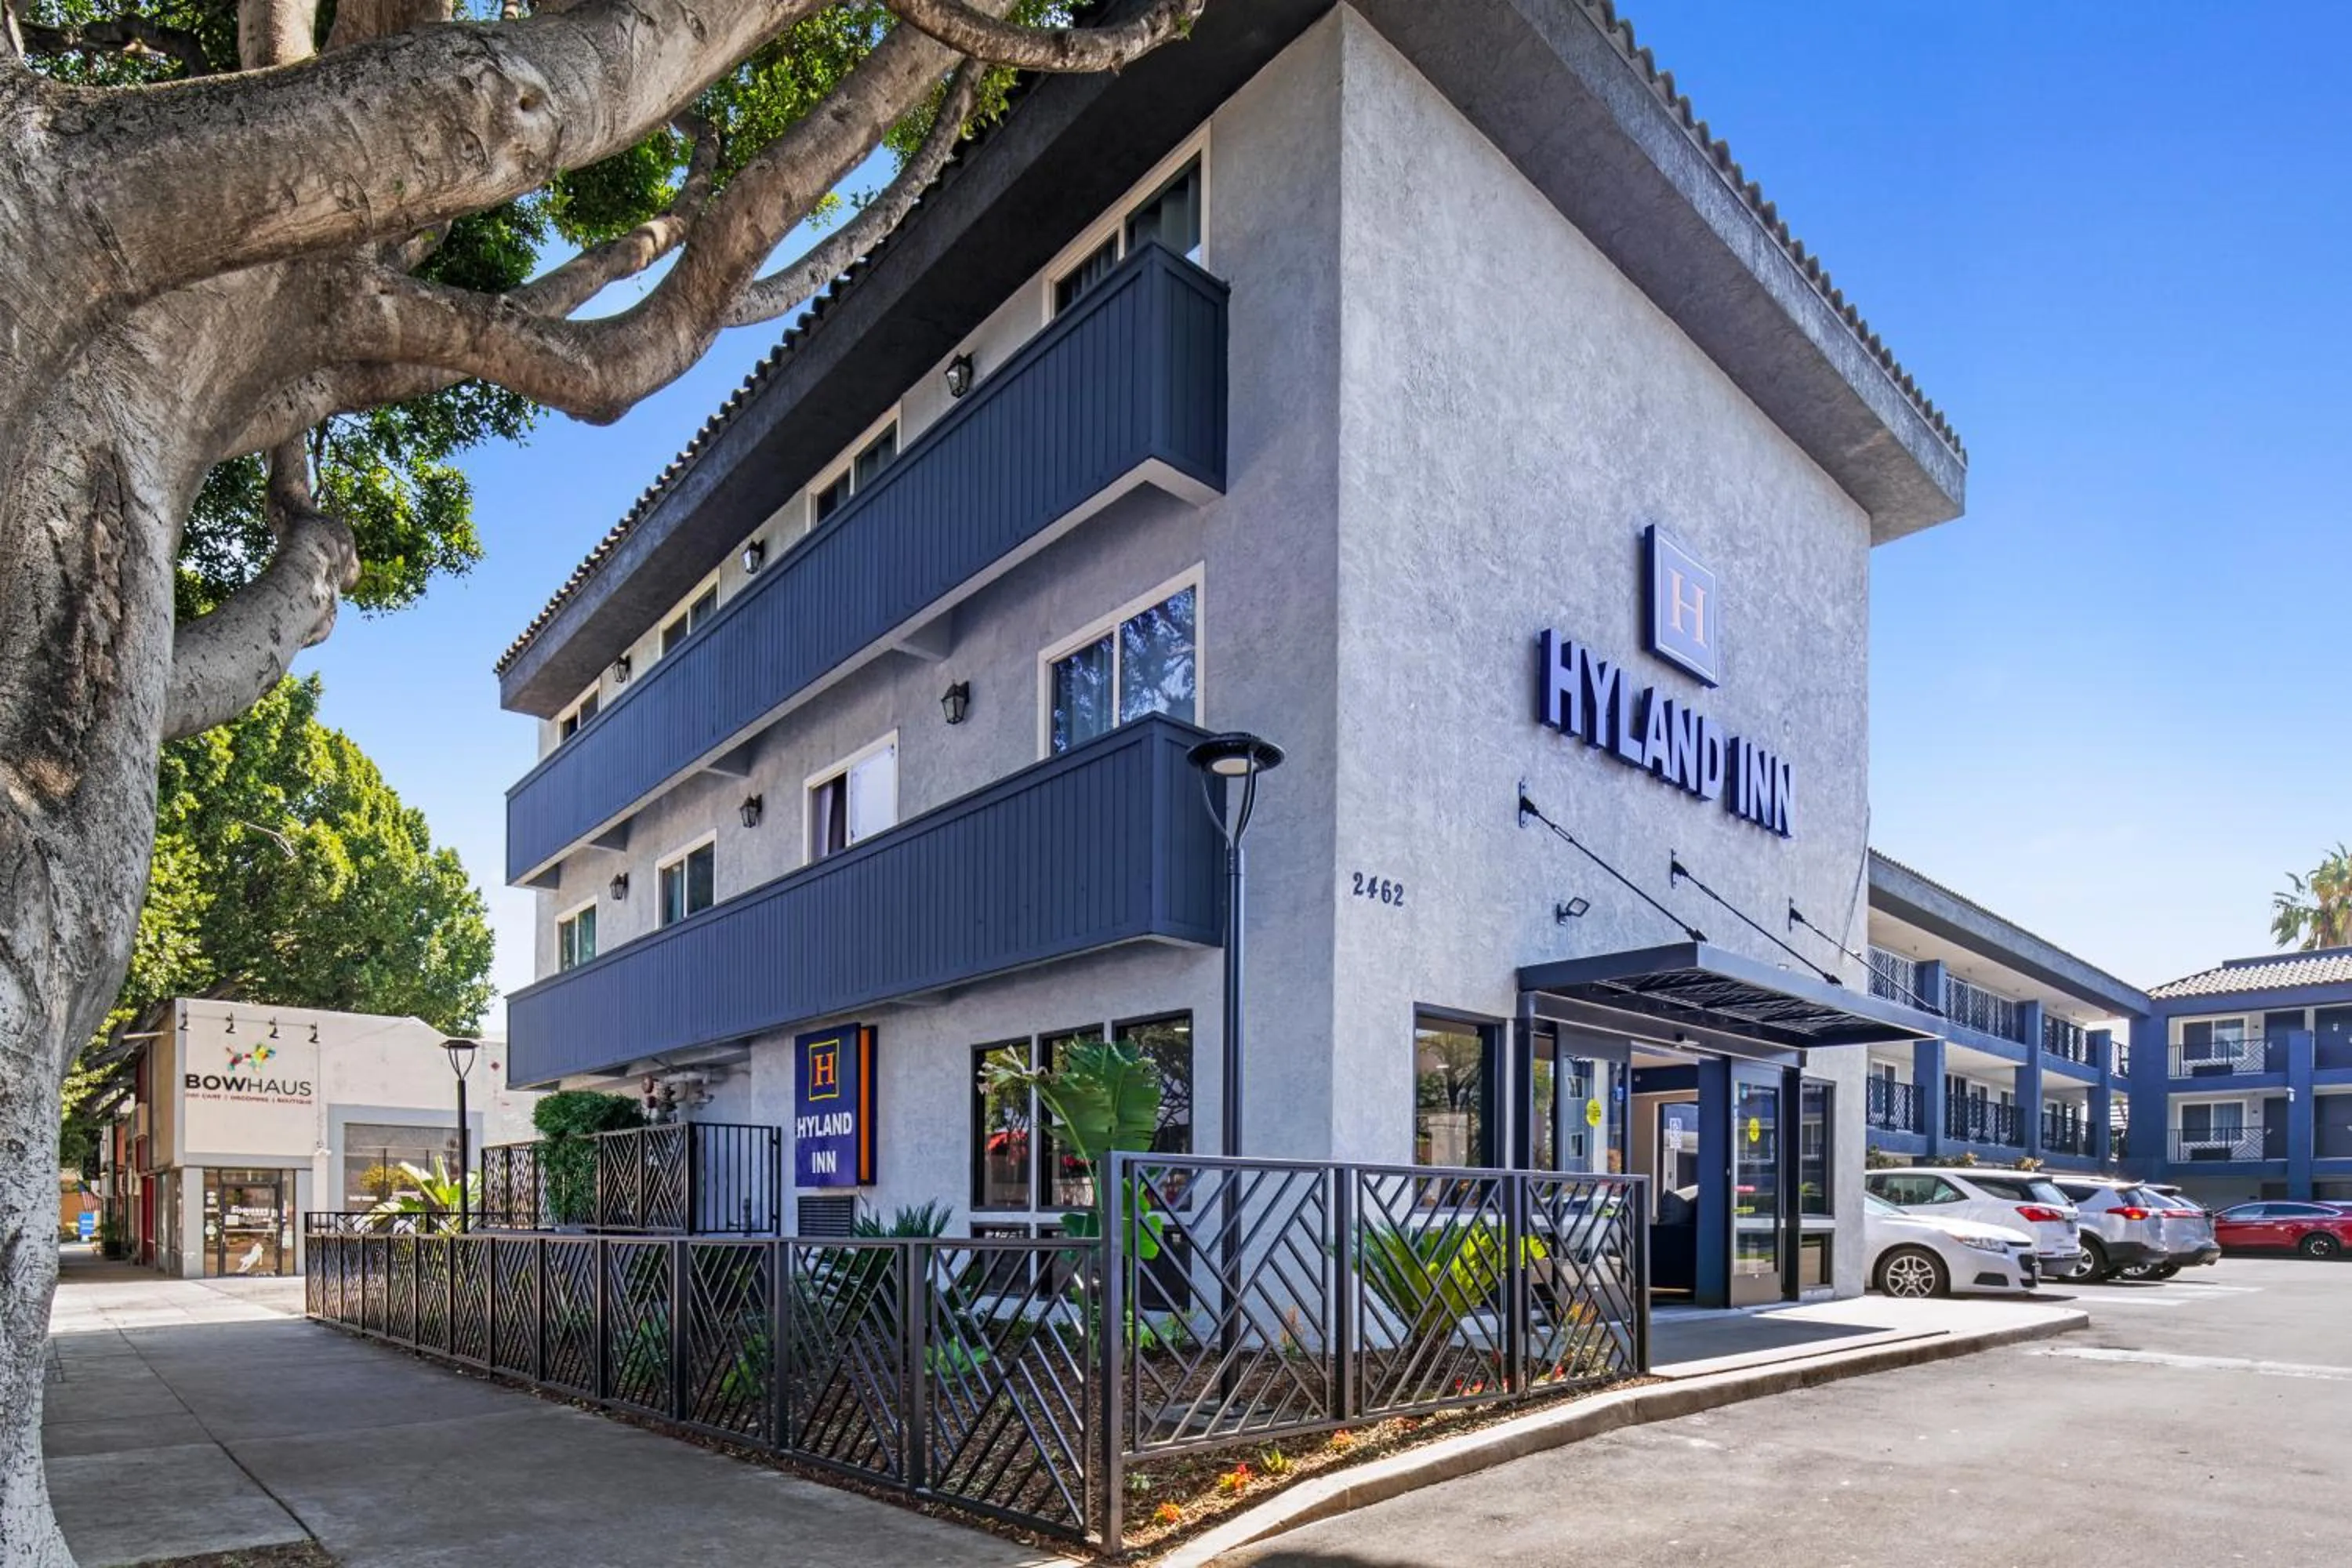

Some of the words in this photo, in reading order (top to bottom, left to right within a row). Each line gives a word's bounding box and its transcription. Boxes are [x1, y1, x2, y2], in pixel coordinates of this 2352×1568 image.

[1668, 567, 1708, 649] H
[1540, 628, 1725, 800] HYLAND
[1729, 736, 1795, 837] INN
[1353, 871, 1404, 907] 2462
[184, 1073, 312, 1097] BOWHAUS
[814, 1051, 835, 1086] H
[797, 1111, 853, 1138] HYLAND
[811, 1150, 837, 1174] INN
